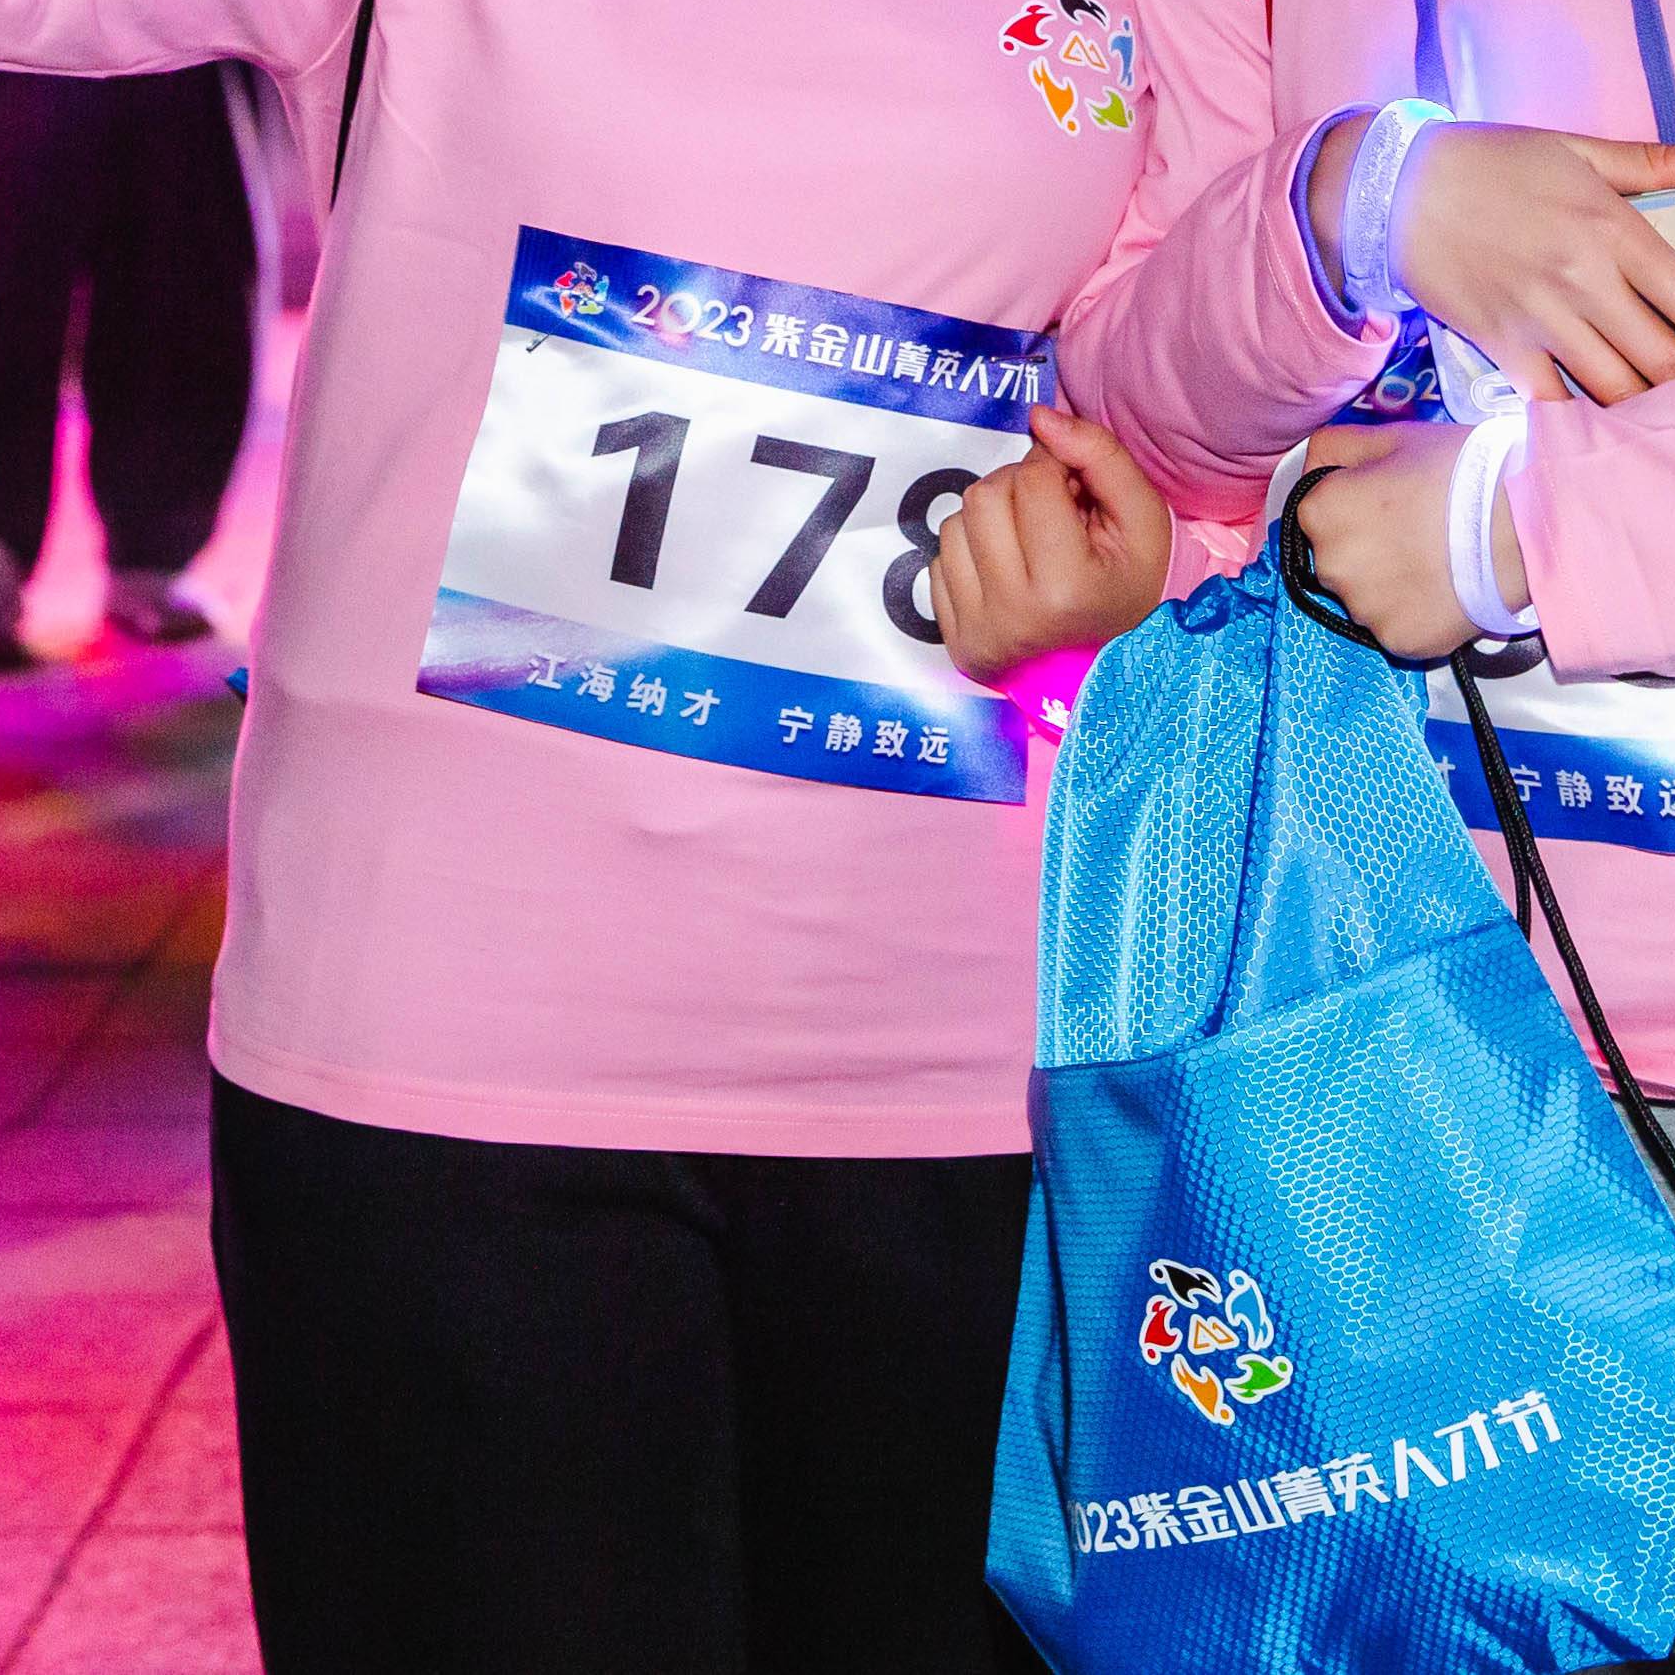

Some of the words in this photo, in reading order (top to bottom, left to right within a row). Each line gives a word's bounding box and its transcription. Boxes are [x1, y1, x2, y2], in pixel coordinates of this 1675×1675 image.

[526, 650, 722, 727] 江海纳才
[777, 705, 952, 765] 宁静致远
[1068, 1389, 1562, 1555] 023紫金山菁英人才节
